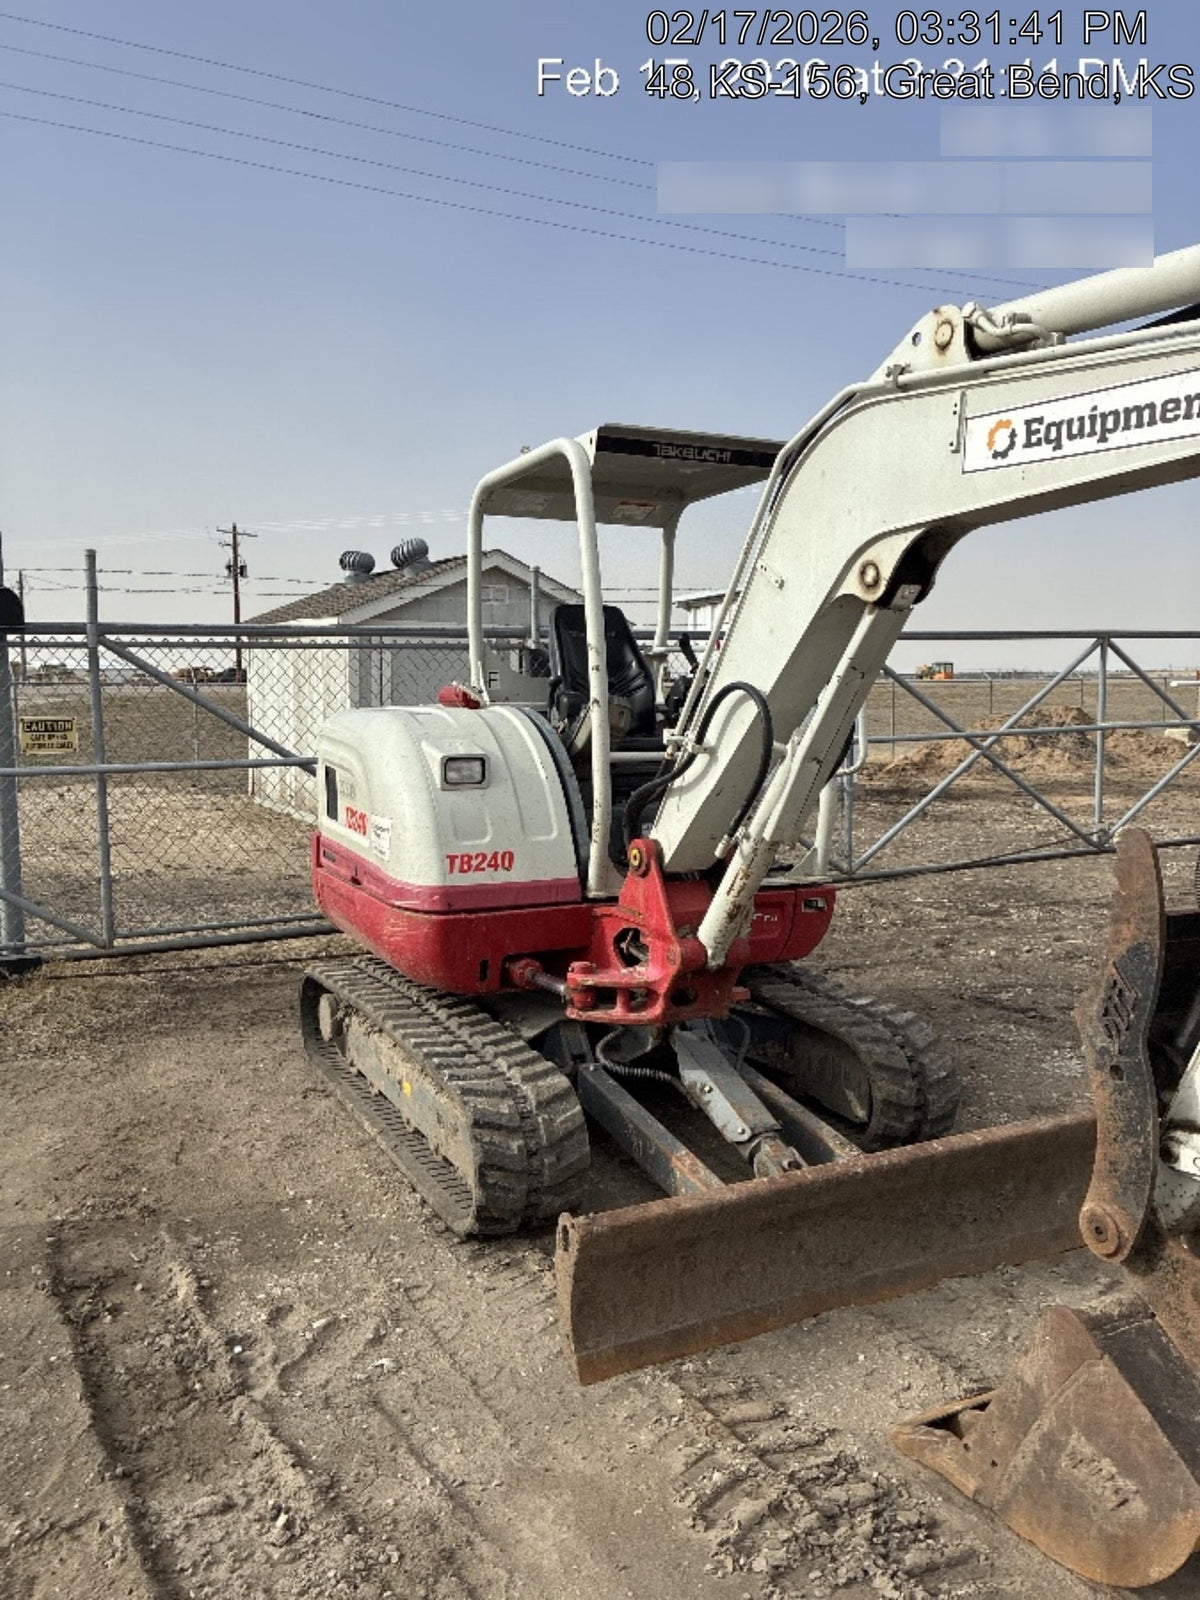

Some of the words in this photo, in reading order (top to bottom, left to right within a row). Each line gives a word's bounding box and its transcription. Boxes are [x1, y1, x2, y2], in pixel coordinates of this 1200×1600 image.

[488, 671, 499, 689] F
[24, 721, 72, 731] CAUTION
[446, 851, 515, 874] TB240
